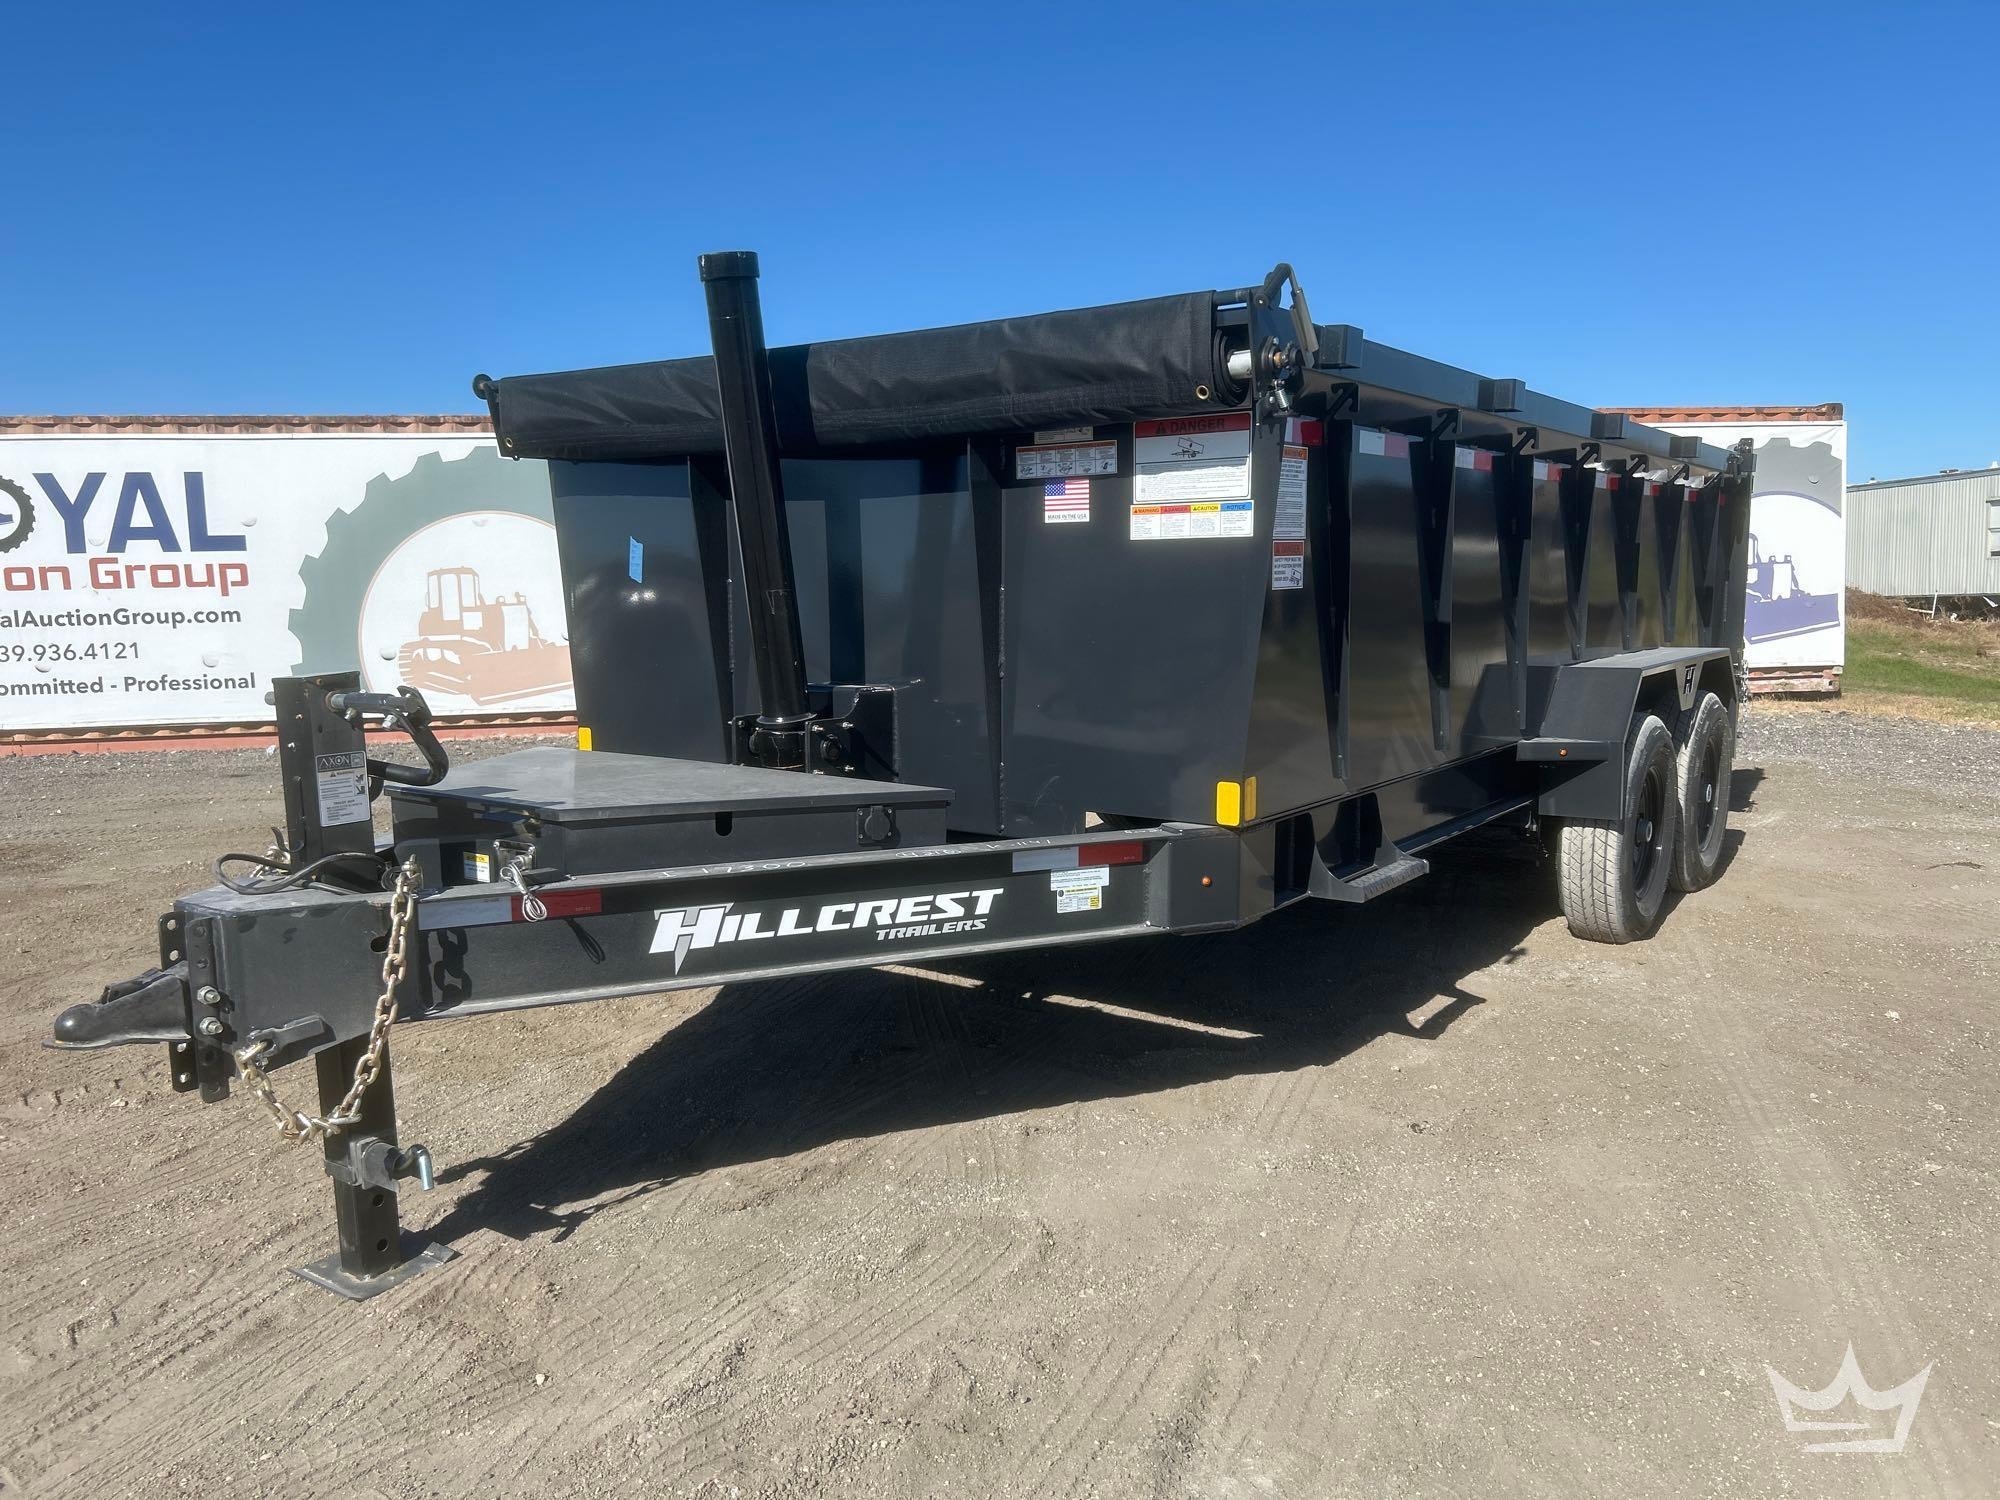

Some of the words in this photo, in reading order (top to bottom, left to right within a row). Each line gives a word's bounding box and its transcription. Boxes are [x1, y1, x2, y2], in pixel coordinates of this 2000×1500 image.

[1170, 418, 1225, 434] DANGER
[3, 566, 72, 591] on
[88, 557, 249, 597] Group
[0, 608, 242, 629] alAuctionGroup.com
[0, 642, 140, 662] 39.936.4121
[0, 676, 104, 697] ommitted
[123, 672, 257, 693] Professional
[319, 755, 350, 768] AXON
[649, 888, 1004, 975] HILLCREST
[875, 918, 988, 941] TRAILERS
